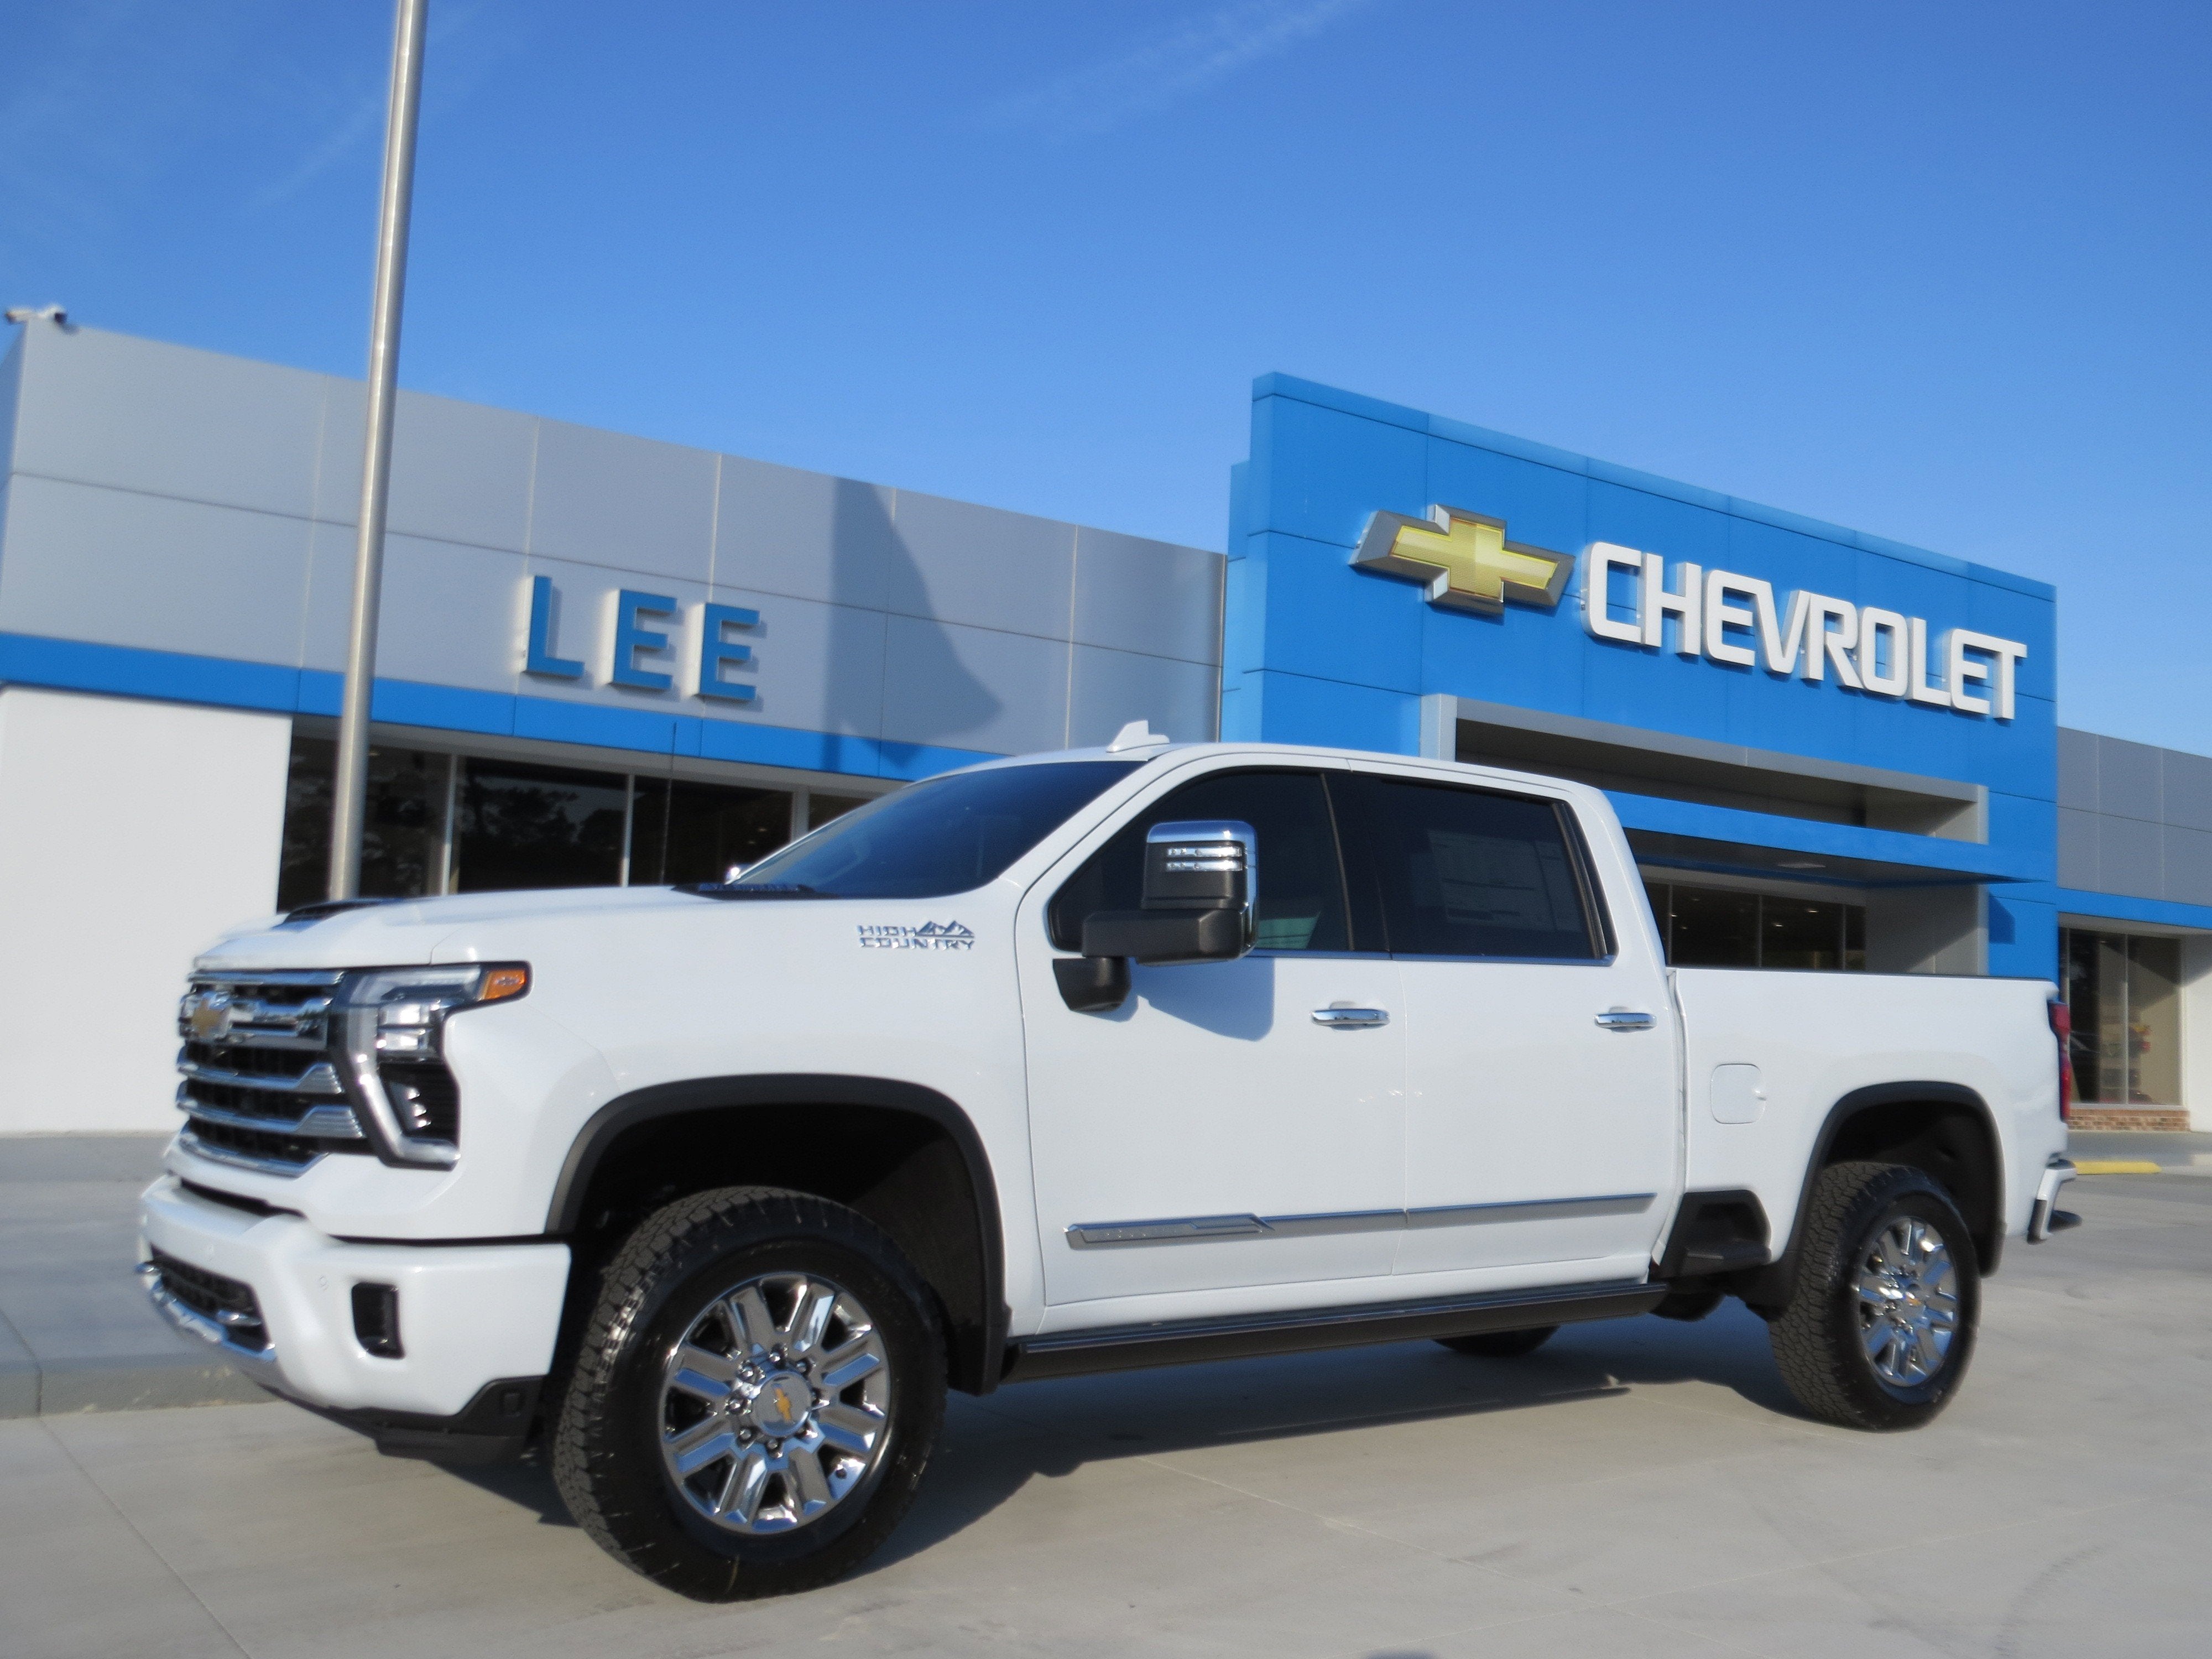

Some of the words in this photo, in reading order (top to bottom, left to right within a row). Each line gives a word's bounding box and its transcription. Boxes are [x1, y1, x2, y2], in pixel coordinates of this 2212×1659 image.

[517, 575, 760, 702] LEE
[1582, 541, 2027, 721] CHEVROLET
[857, 925, 916, 937] HIGH
[859, 937, 975, 951] COUNTRY
